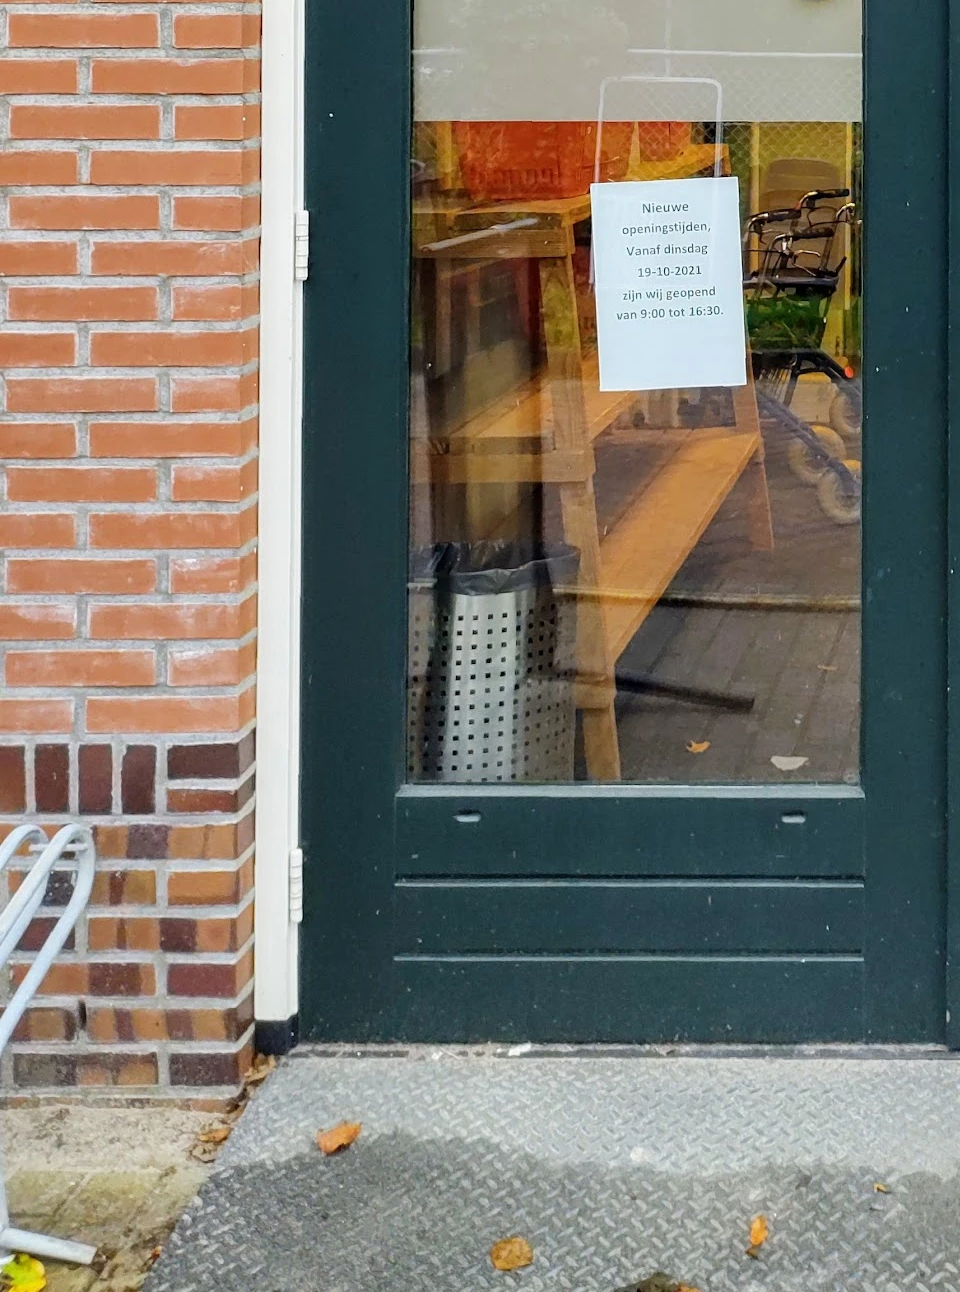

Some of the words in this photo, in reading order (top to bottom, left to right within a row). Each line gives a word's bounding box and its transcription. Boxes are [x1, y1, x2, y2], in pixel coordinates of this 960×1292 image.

[642, 202, 689, 214] Nieuwe
[622, 221, 711, 236] openingstijden,
[626, 244, 661, 256] Vanaf
[664, 243, 708, 255] dinsdag
[637, 265, 702, 278] 19-10-2021
[622, 290, 642, 302] zijn
[645, 288, 663, 300] wij
[666, 286, 716, 301] geopend
[616, 310, 637, 320] van
[640, 307, 665, 319] 9:00
[668, 307, 685, 317] tot
[689, 305, 724, 317] 16:30.
